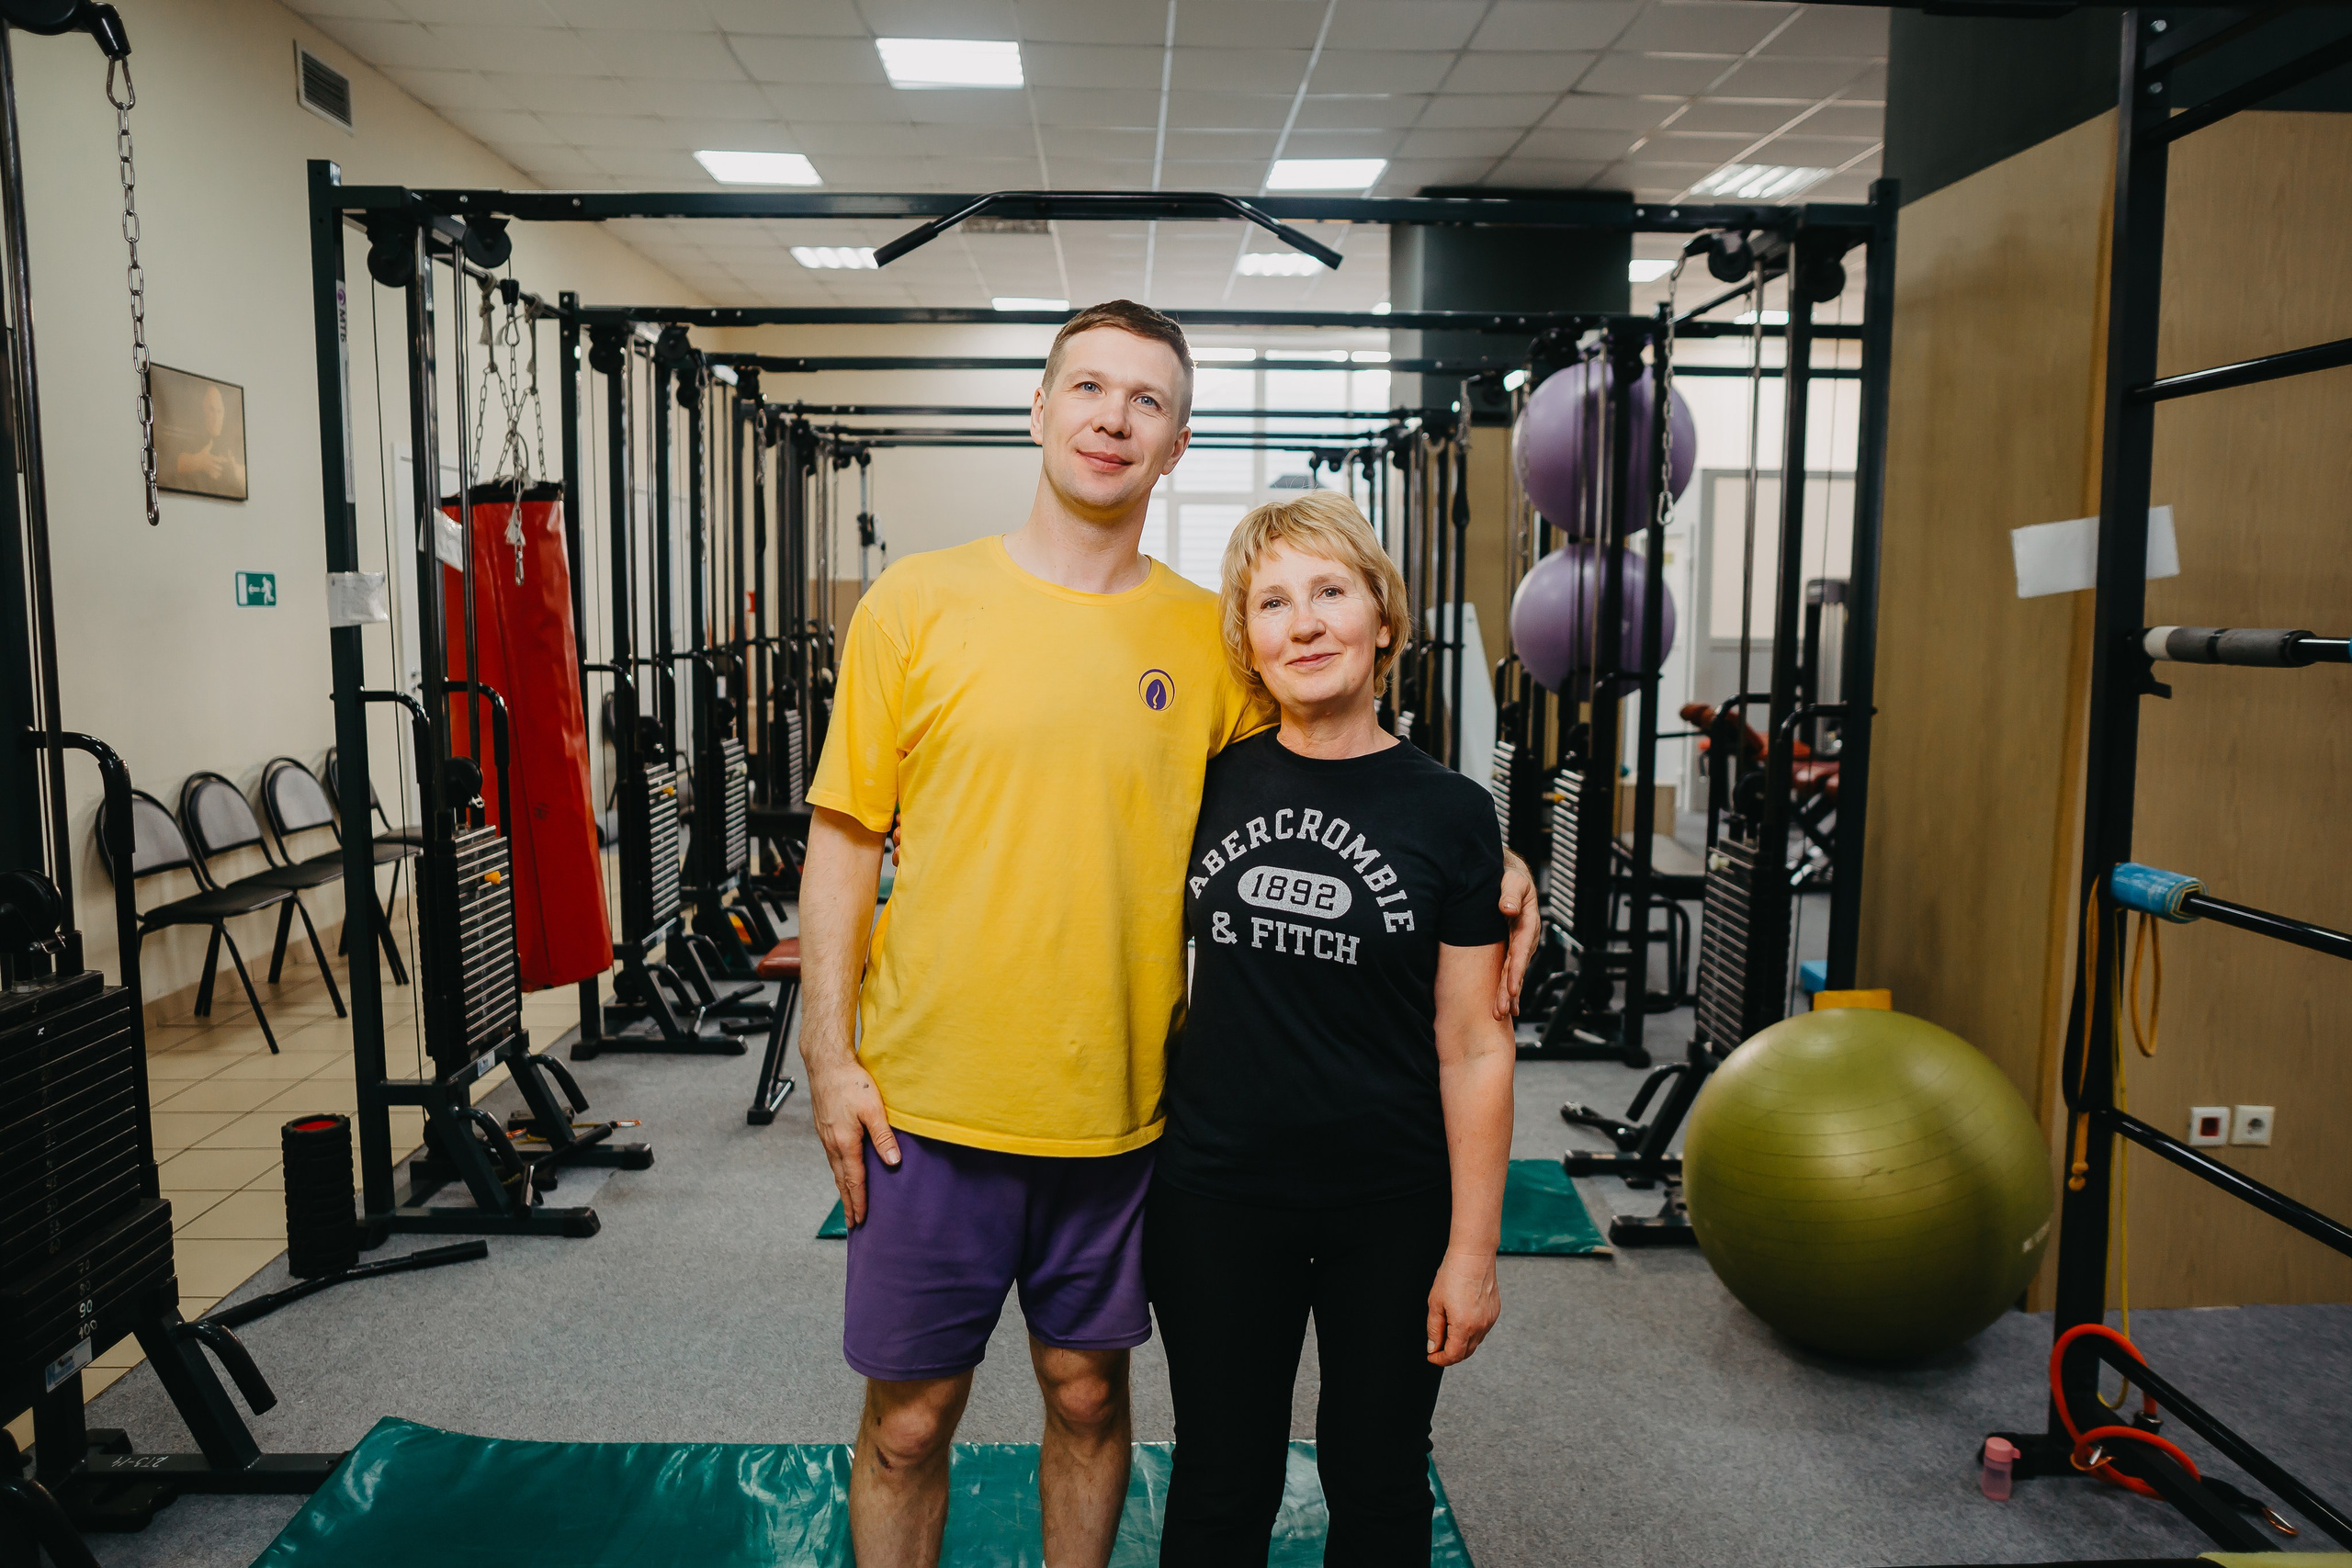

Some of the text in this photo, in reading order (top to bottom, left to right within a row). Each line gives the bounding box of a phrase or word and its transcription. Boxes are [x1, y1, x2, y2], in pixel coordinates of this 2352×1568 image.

[1189, 808, 1415, 933] ABERCROMBIE
[1250, 873, 1337, 911] 1892
[1212, 910, 1360, 965] & FITCH
[77, 1258, 90, 1274] 70
[79, 1280, 91, 1296] 80
[79, 1299, 93, 1318] 90
[78, 1319, 97, 1339] 100
